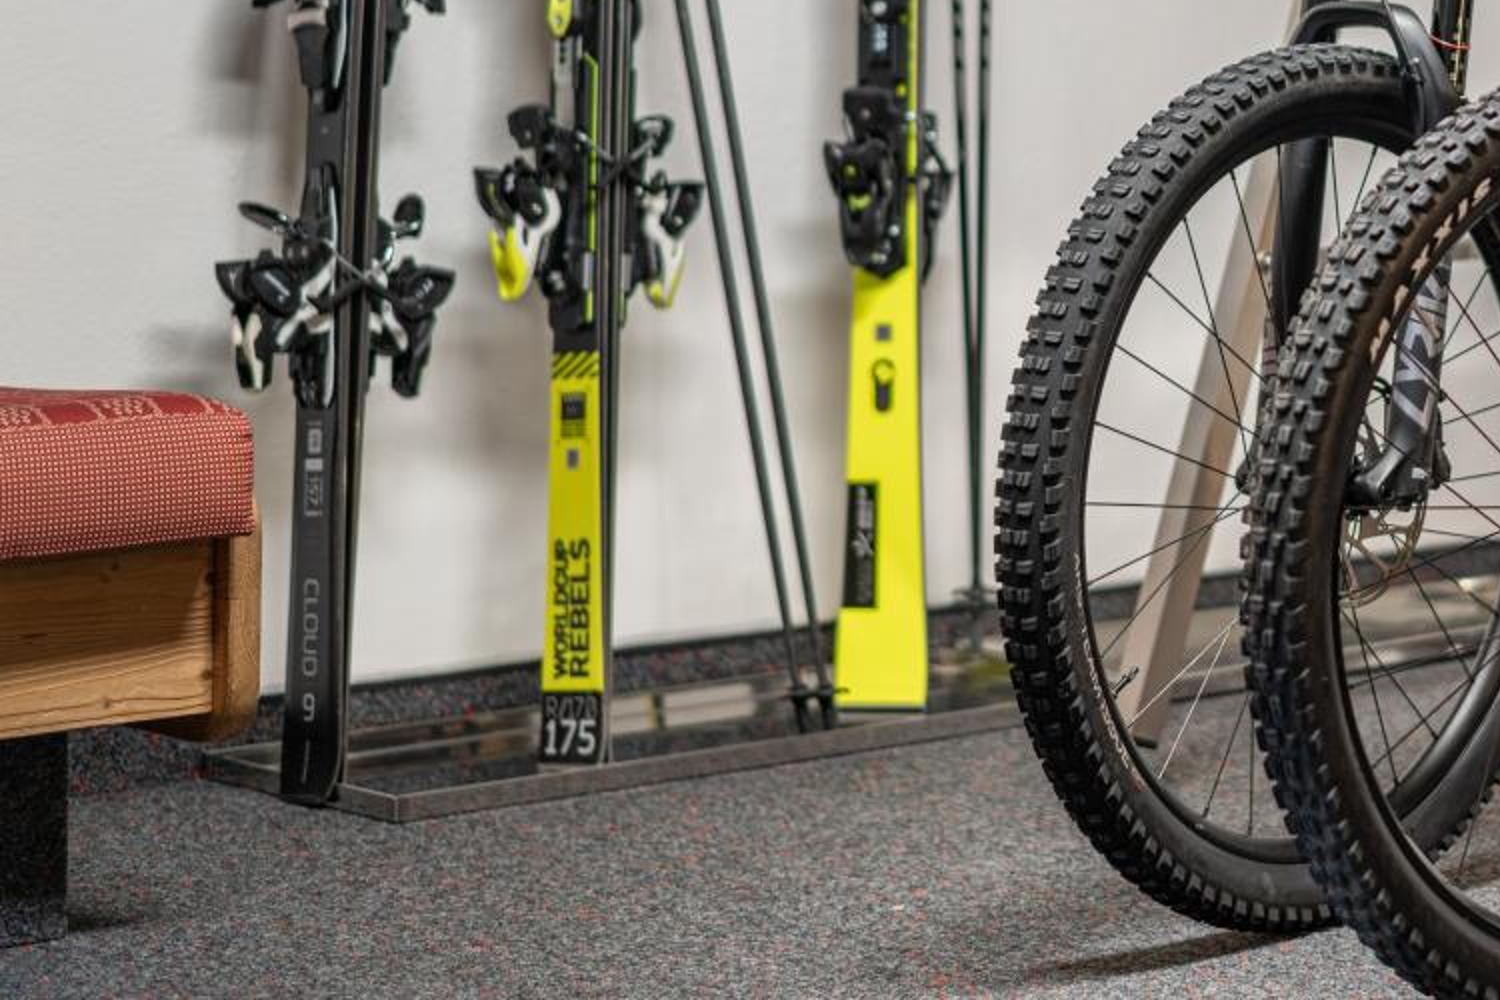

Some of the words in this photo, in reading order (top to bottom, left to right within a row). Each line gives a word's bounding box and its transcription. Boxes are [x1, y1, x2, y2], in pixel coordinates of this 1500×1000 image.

[301, 577, 320, 677] CLOUD
[553, 538, 569, 678] WORLDCUP
[570, 538, 591, 678] REBELS
[543, 719, 596, 755] 175
